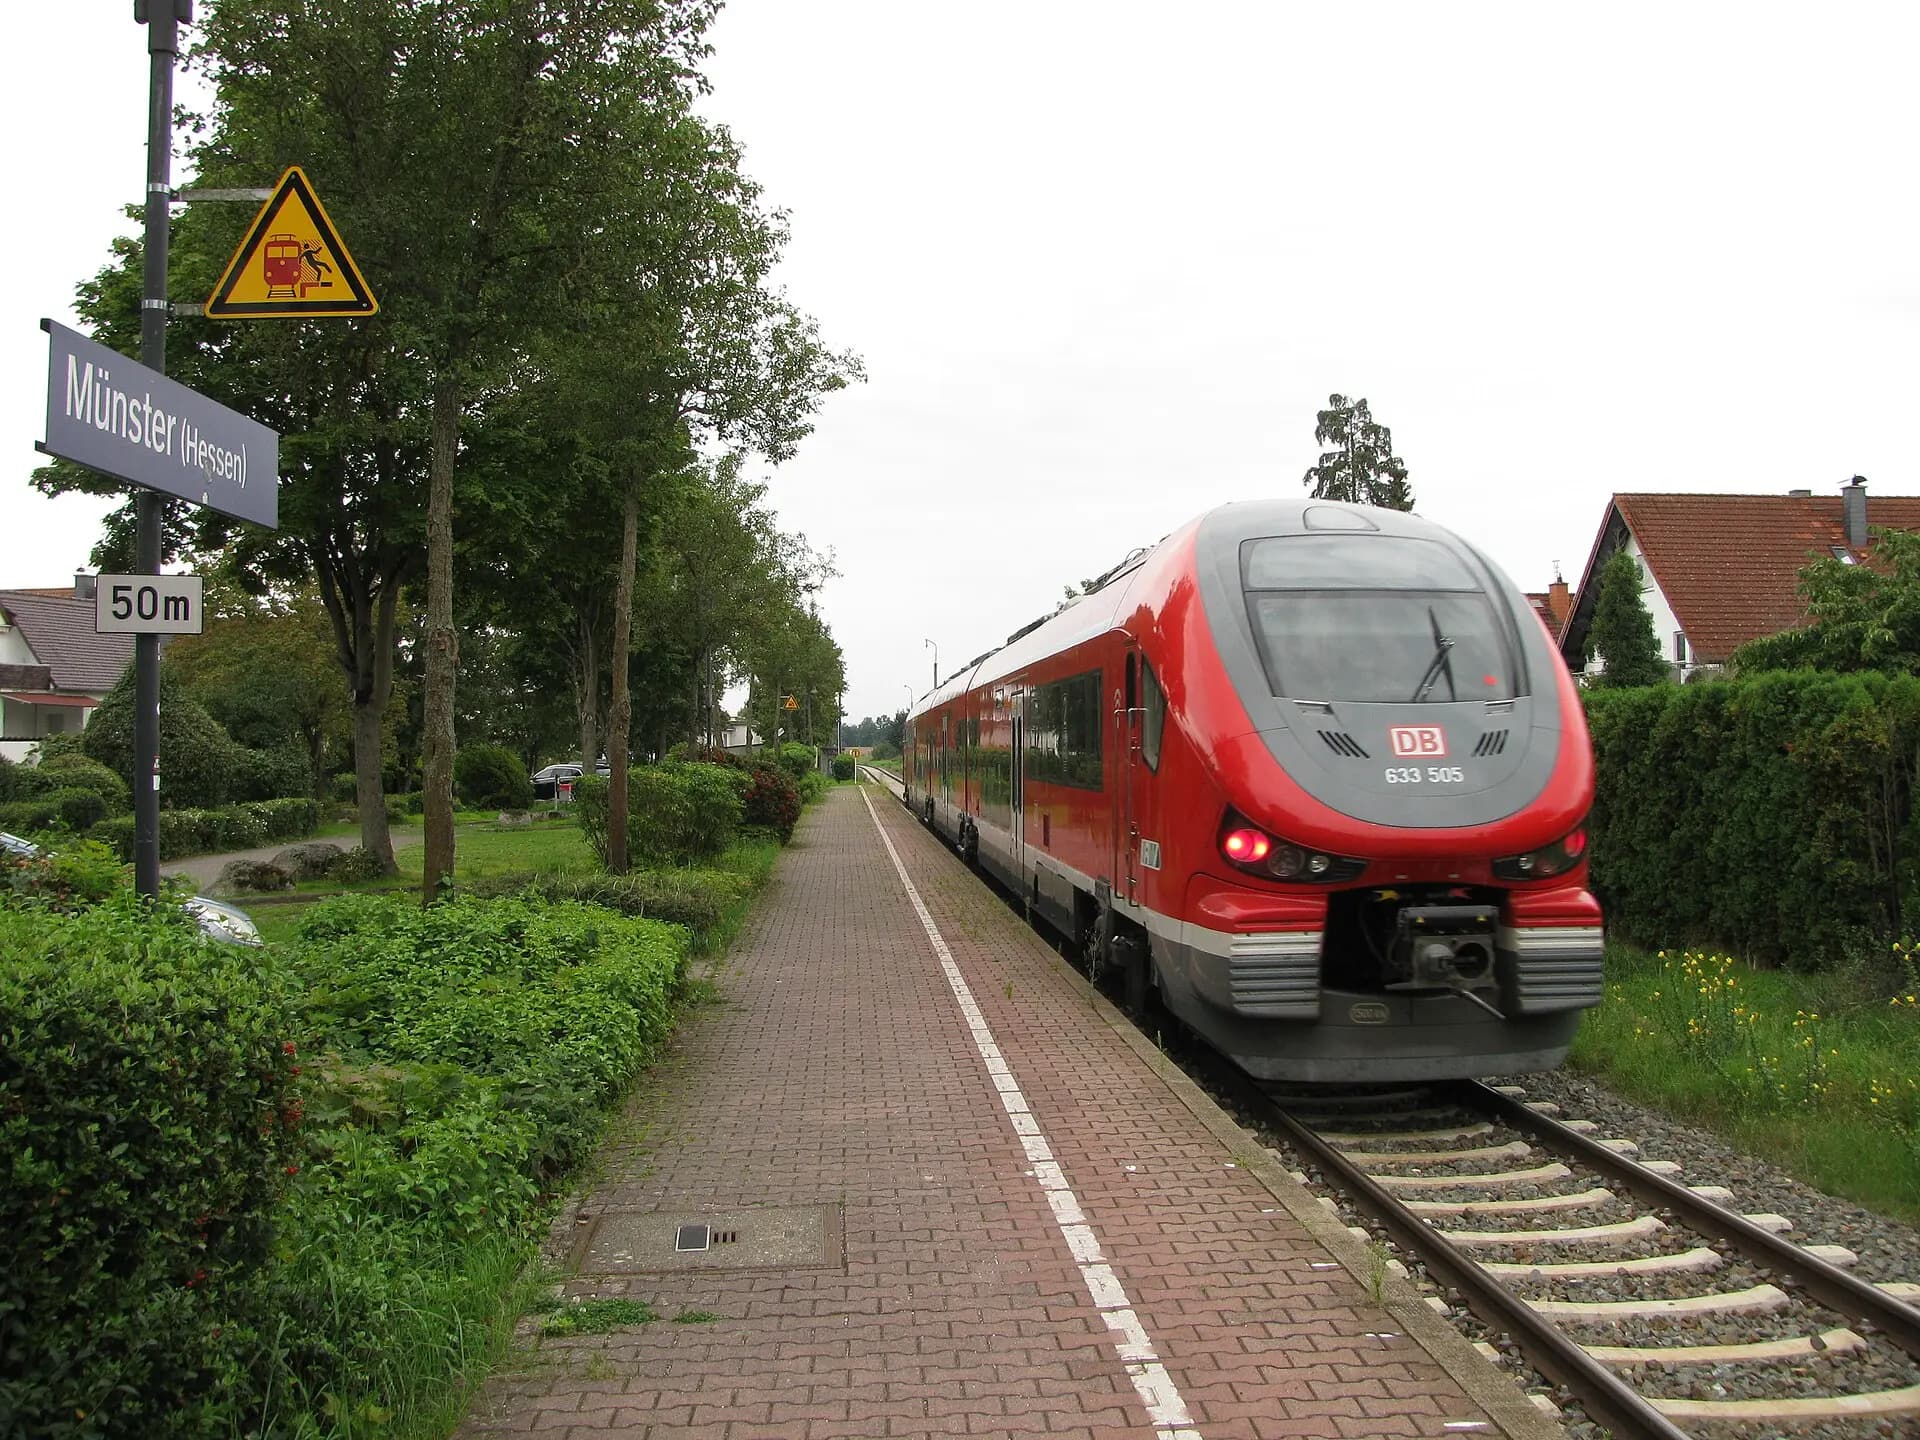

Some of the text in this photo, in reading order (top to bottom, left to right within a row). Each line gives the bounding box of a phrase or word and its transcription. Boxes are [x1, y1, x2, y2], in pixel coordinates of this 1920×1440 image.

[65, 353, 248, 489] Münster (Hessen)
[1396, 730, 1439, 753] DB
[1384, 766, 1465, 784] 633 505
